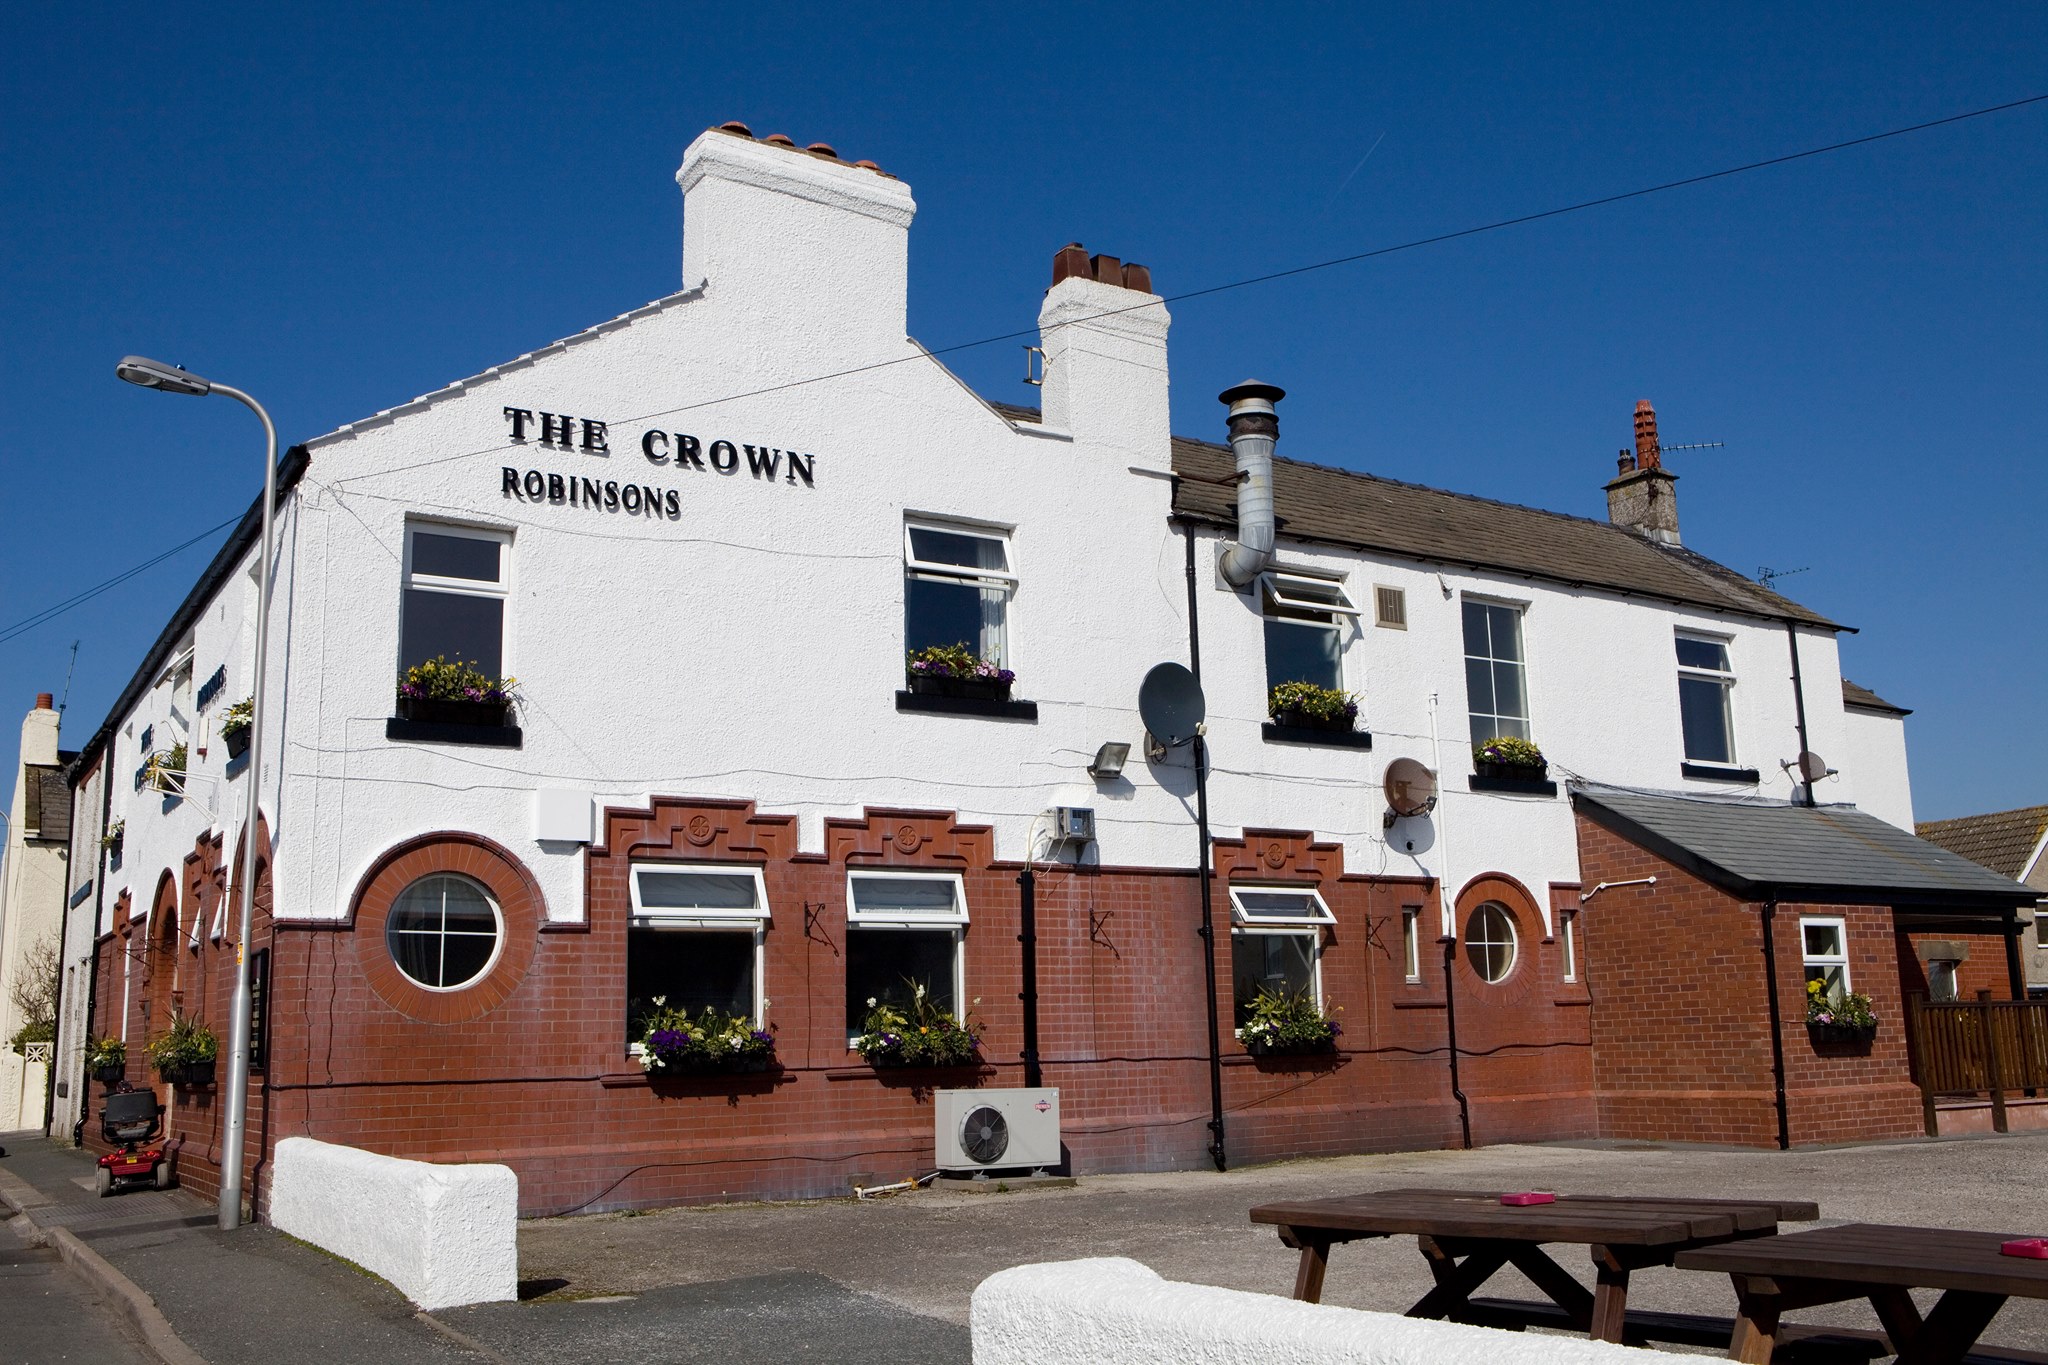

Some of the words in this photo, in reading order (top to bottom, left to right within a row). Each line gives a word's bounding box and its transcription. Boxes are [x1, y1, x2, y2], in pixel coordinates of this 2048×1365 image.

[503, 406, 609, 452] THE
[641, 429, 815, 483] CROWN
[501, 466, 680, 515] ROBINSONS
